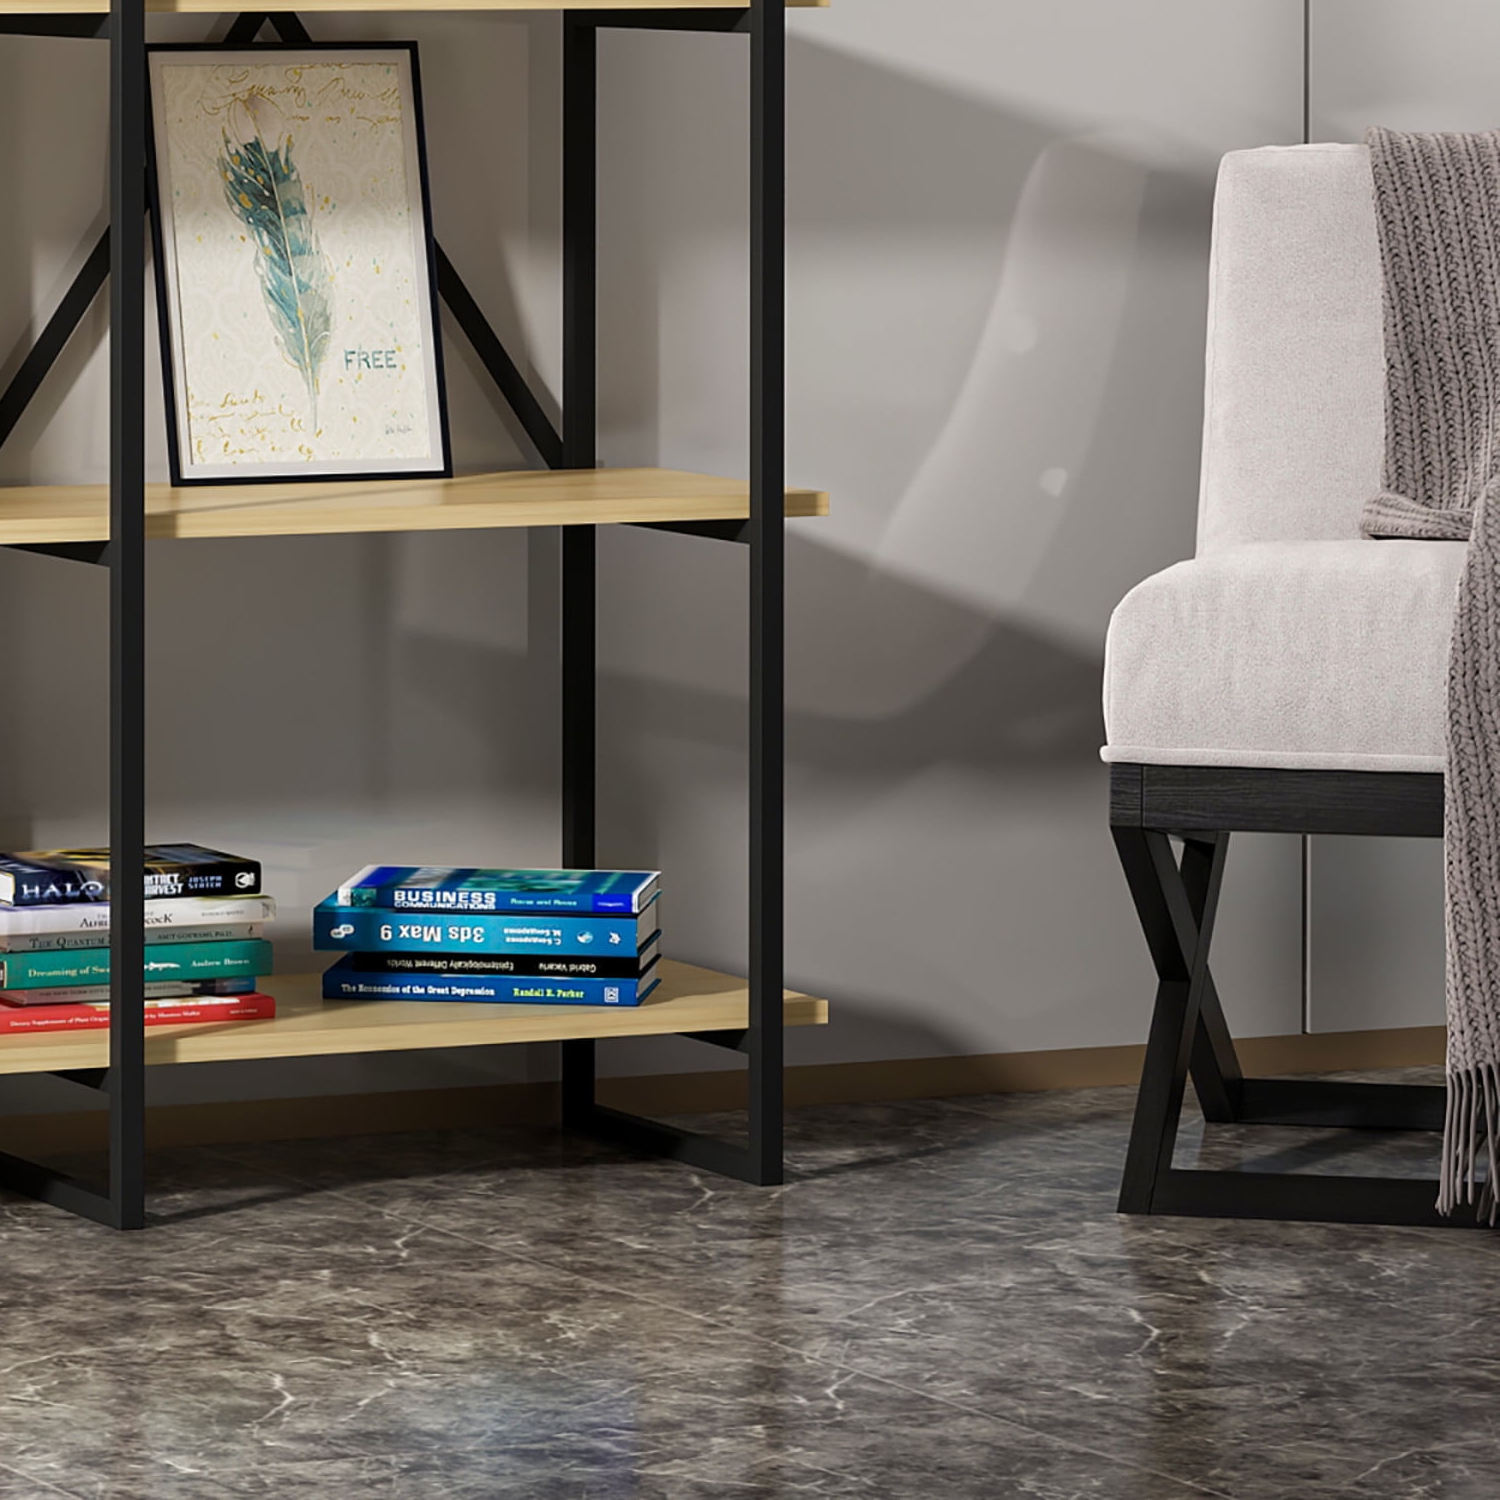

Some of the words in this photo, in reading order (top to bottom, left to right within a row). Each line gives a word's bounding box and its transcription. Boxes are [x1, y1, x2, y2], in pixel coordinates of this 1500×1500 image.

[343, 349, 397, 370] FREE
[144, 873, 180, 885] NTACT
[20, 879, 105, 900] HALO
[393, 889, 497, 904] BUSINESS
[393, 901, 496, 910] COMMUNICATIONS
[380, 923, 392, 940] 9
[397, 925, 442, 942] Max
[448, 925, 485, 943] 3ds
[29, 937, 52, 949] THE
[56, 935, 105, 949] QUANTUM
[190, 958, 221, 968] Andrew
[223, 957, 250, 967] Brown
[387, 959, 413, 968] Worlds
[414, 959, 448, 969] Different
[449, 958, 514, 971] Epistemologically
[569, 963, 597, 973] Gabriel
[28, 966, 78, 979] Dreaming
[79, 965, 90, 976] of
[341, 984, 356, 993] The
[358, 984, 400, 994] Economics
[401, 984, 411, 994] of
[412, 985, 426, 994] the
[427, 986, 450, 995] Great
[451, 986, 496, 998] Depression
[513, 988, 545, 997] Randall
[556, 989, 585, 999] Parker
